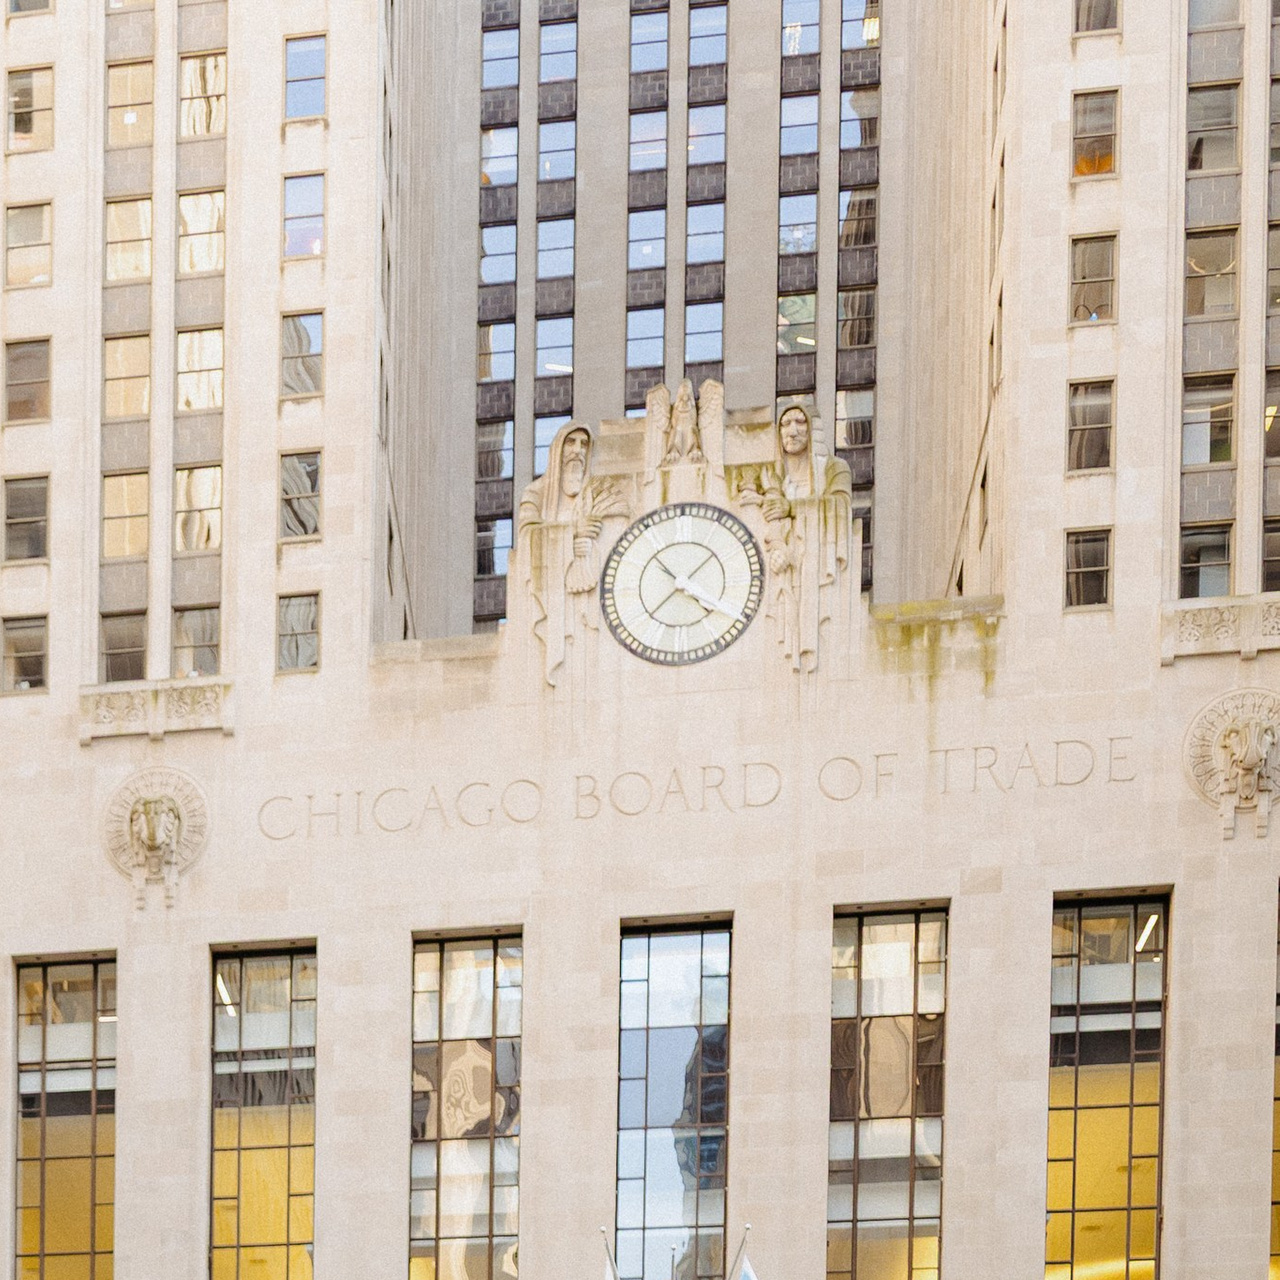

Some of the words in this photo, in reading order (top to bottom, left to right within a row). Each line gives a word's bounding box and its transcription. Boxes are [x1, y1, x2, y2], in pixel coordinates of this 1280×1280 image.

[258, 779, 544, 840] CHICAGO
[574, 762, 781, 819] BOARD
[818, 753, 898, 801] OF
[929, 736, 1137, 794] TRADE
